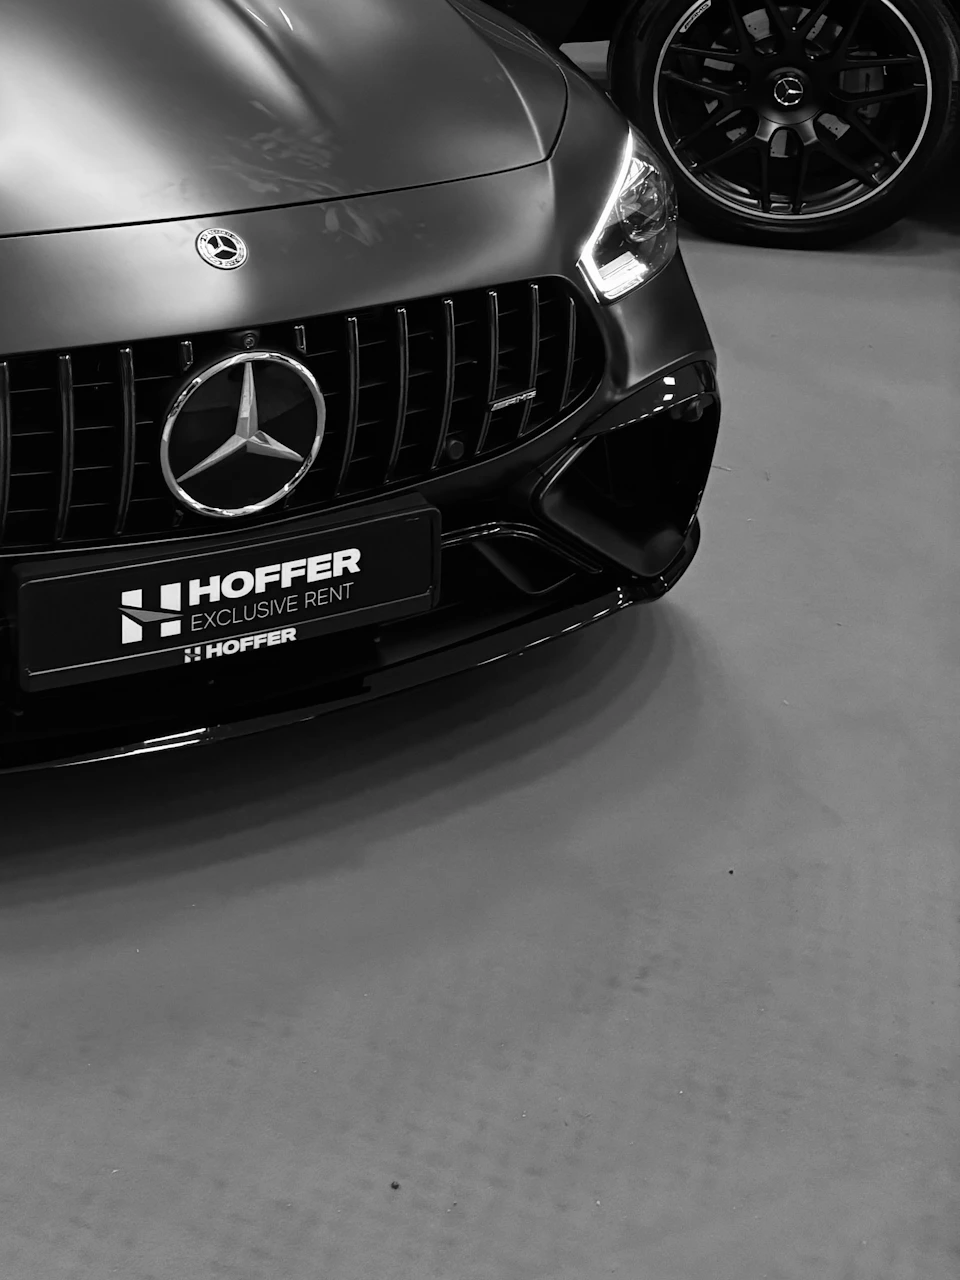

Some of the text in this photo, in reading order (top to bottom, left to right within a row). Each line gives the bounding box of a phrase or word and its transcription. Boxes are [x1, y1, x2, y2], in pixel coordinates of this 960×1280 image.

[188, 547, 361, 607] HOFFER
[190, 581, 355, 632] EXCLUSIVE RENT
[205, 626, 298, 660] HOFFER
